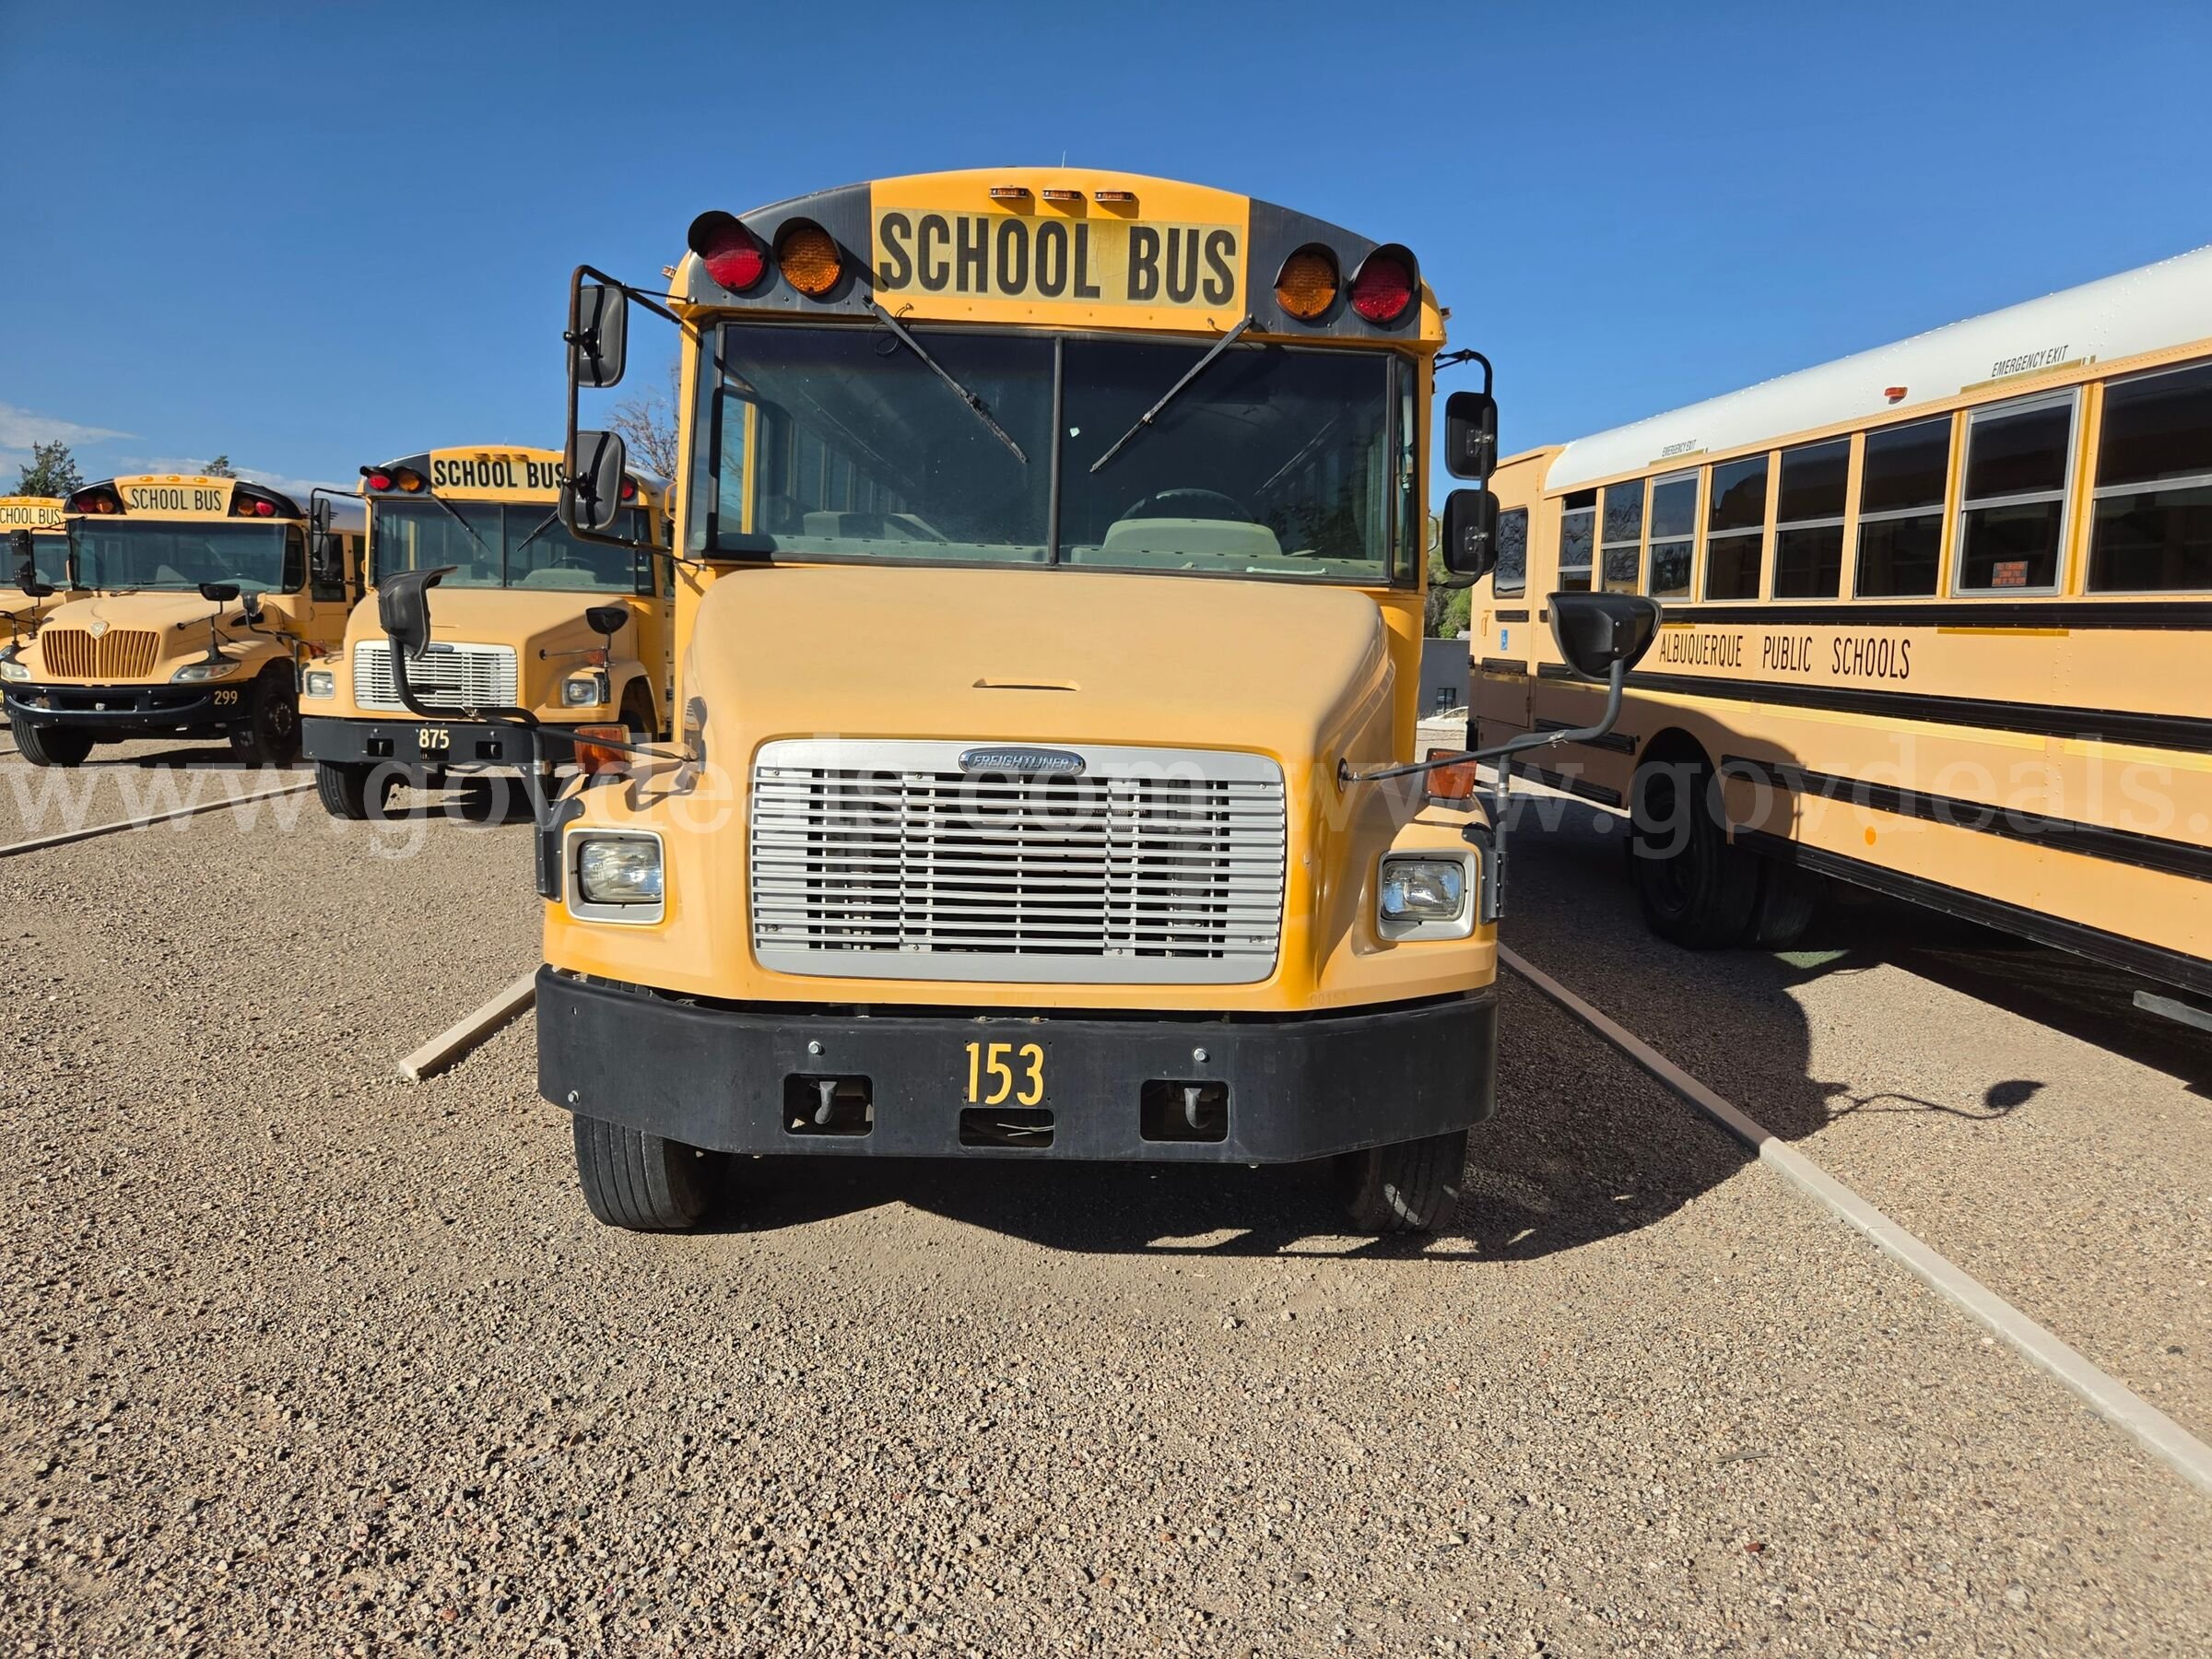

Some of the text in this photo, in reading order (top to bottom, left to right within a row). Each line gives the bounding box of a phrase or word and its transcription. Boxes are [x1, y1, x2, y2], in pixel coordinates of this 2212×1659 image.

[878, 211, 1237, 306] SCHOOL BUS
[1991, 345, 2069, 377] EMERGENCY EXIT
[433, 459, 564, 489] SCHOOL BUS
[131, 488, 222, 511] SCHOOL BUS
[0, 507, 62, 524] CHOOL BUS
[1658, 632, 1912, 680] ALBUQUERQUE PUBLIC SCHOOLS
[213, 689, 239, 706] 299
[418, 728, 450, 749] 875
[972, 754, 1070, 770] FREIGHTLINER
[965, 1041, 1045, 1106] 153
